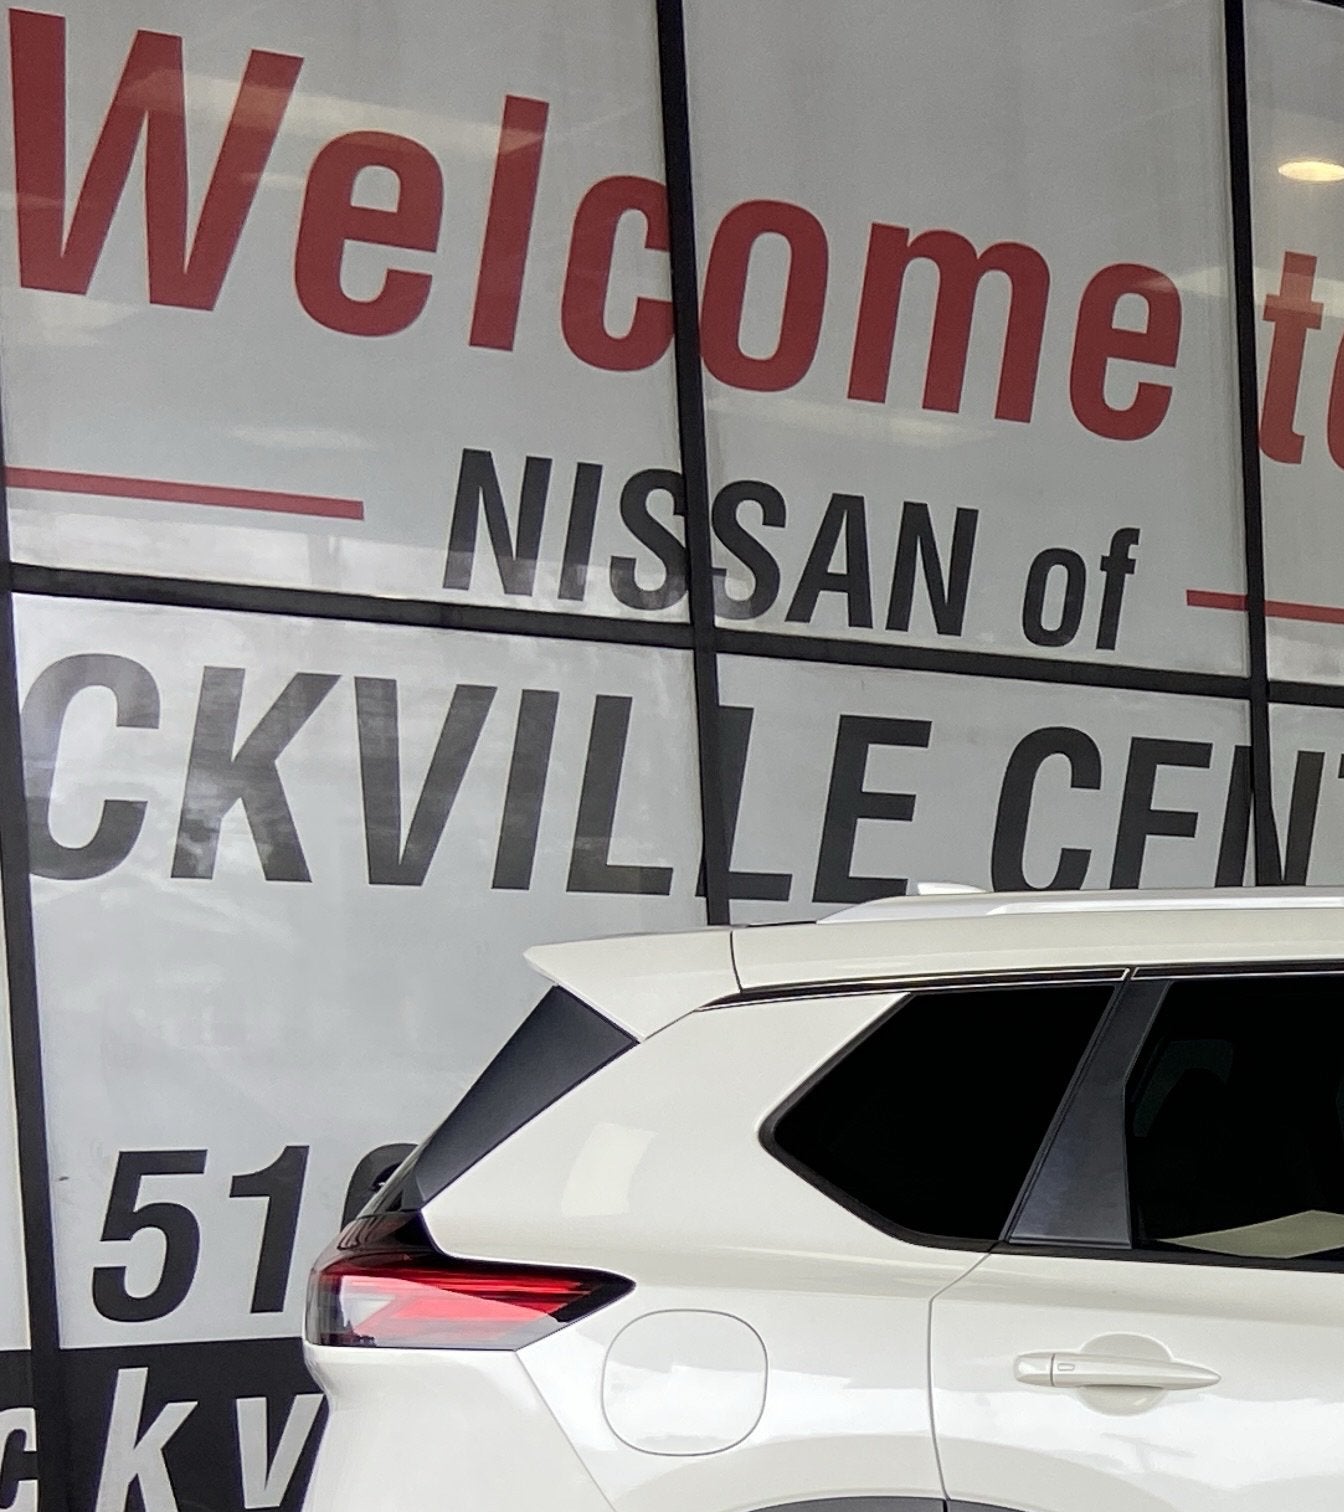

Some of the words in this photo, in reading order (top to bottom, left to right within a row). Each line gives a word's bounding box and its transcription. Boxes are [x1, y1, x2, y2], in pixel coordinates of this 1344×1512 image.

[9, 8, 1182, 442] Welcome
[443, 447, 980, 638] NISSAN
[1021, 527, 1141, 651] of
